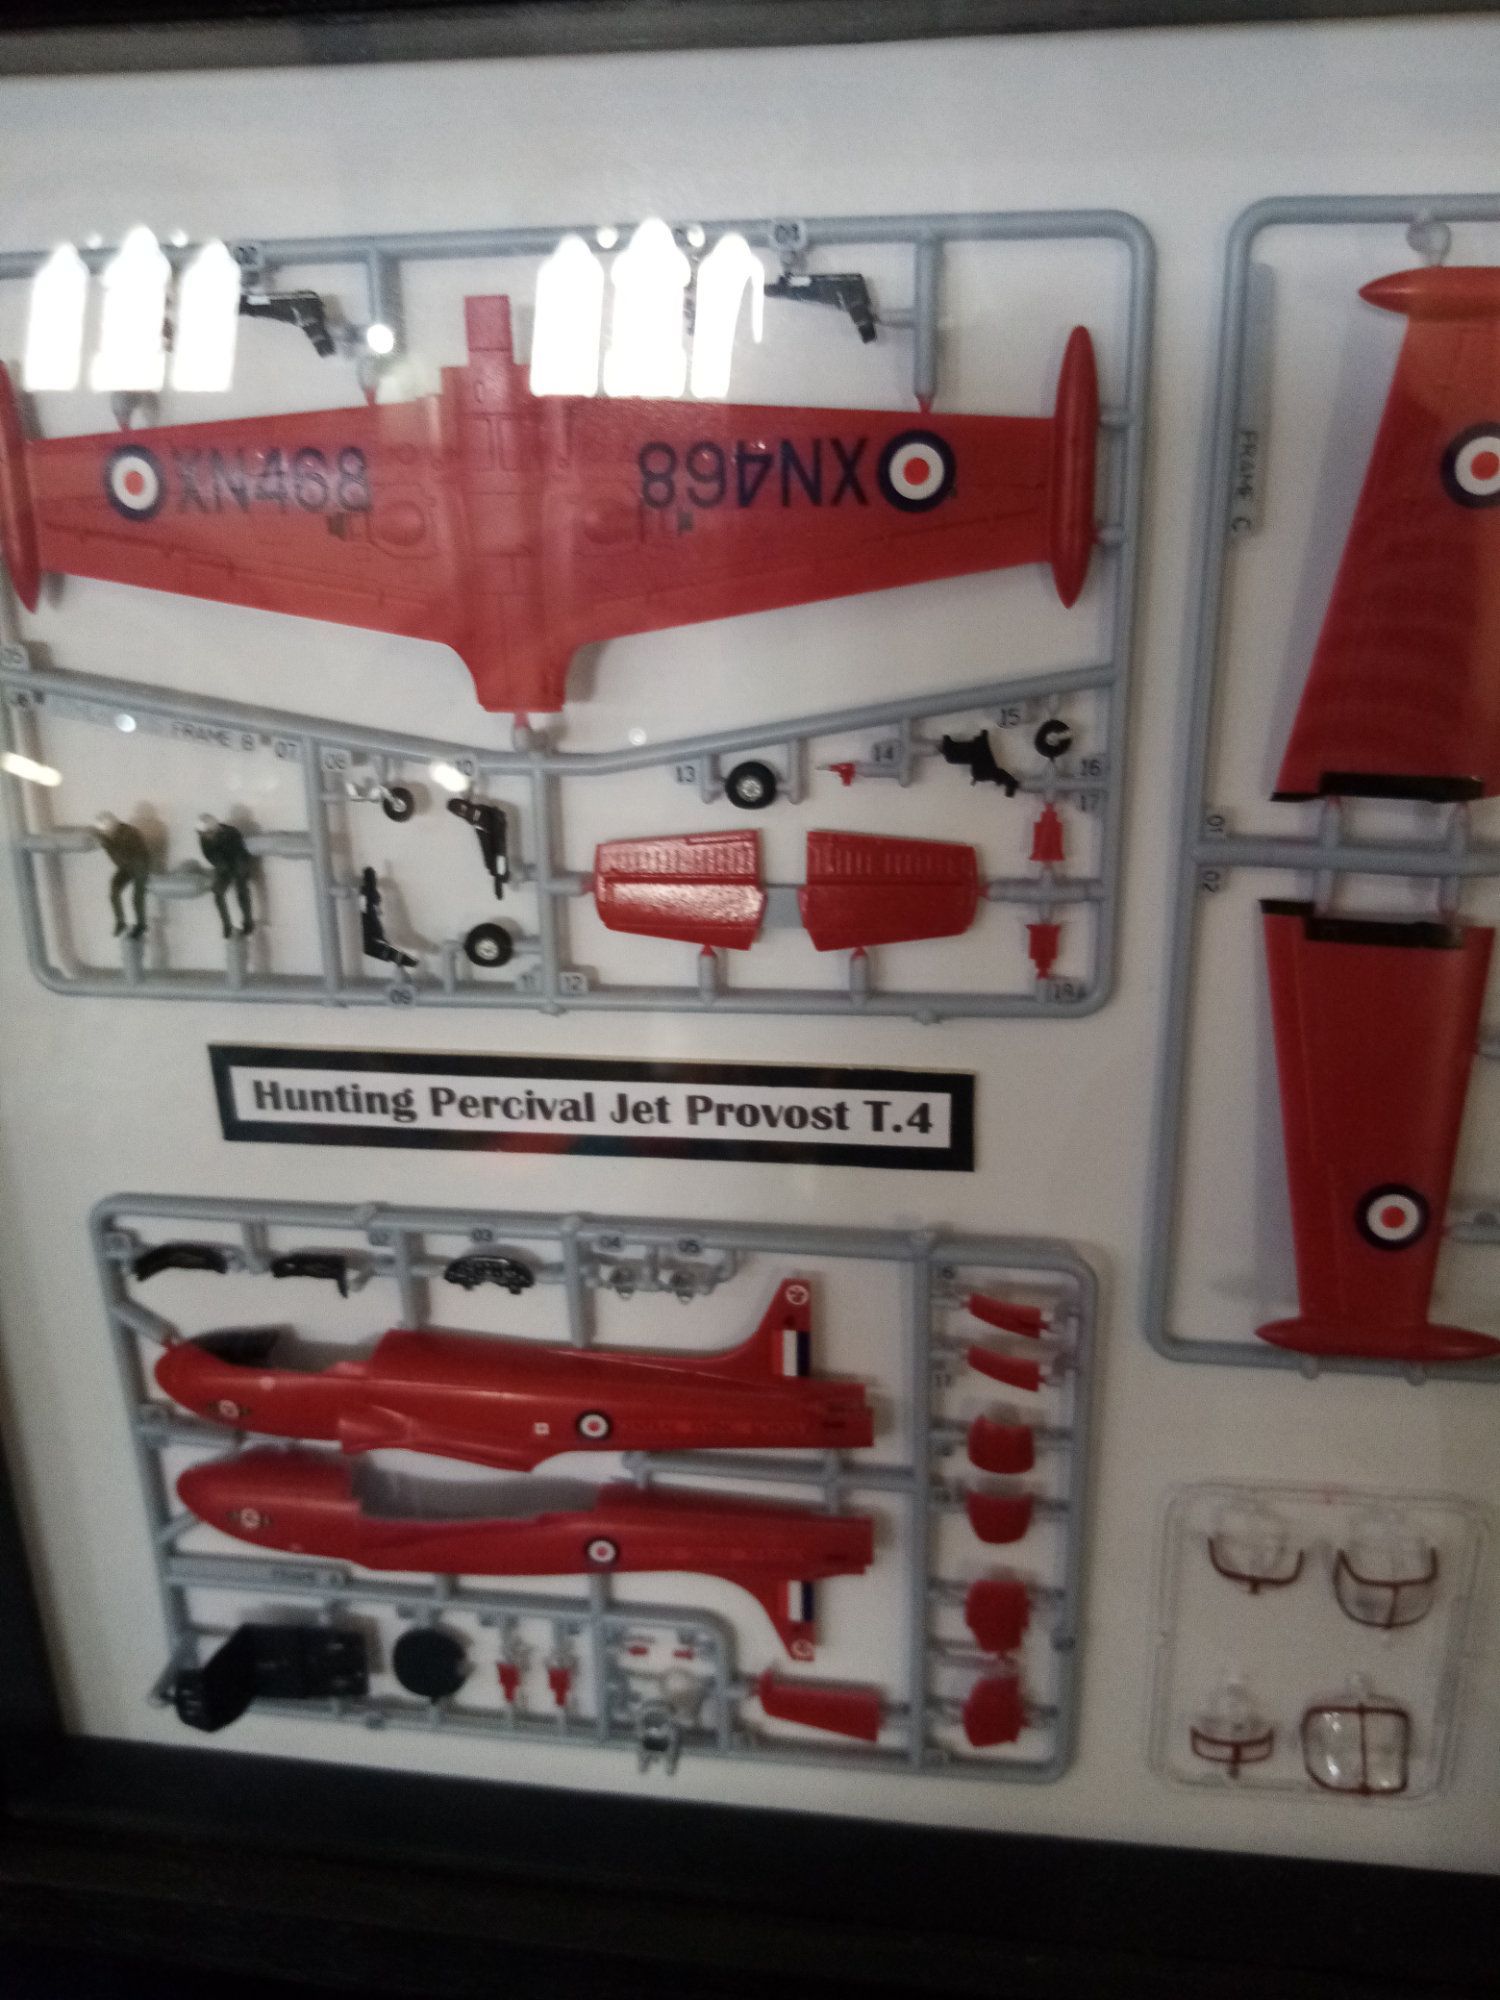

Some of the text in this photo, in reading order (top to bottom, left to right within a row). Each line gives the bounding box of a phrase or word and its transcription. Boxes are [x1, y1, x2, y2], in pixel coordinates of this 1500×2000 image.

[172, 447, 372, 514] XN468
[637, 437, 870, 508] XN468
[675, 764, 697, 783] 13
[252, 1079, 933, 1134] Hunting Percival Jet Provost T.4
